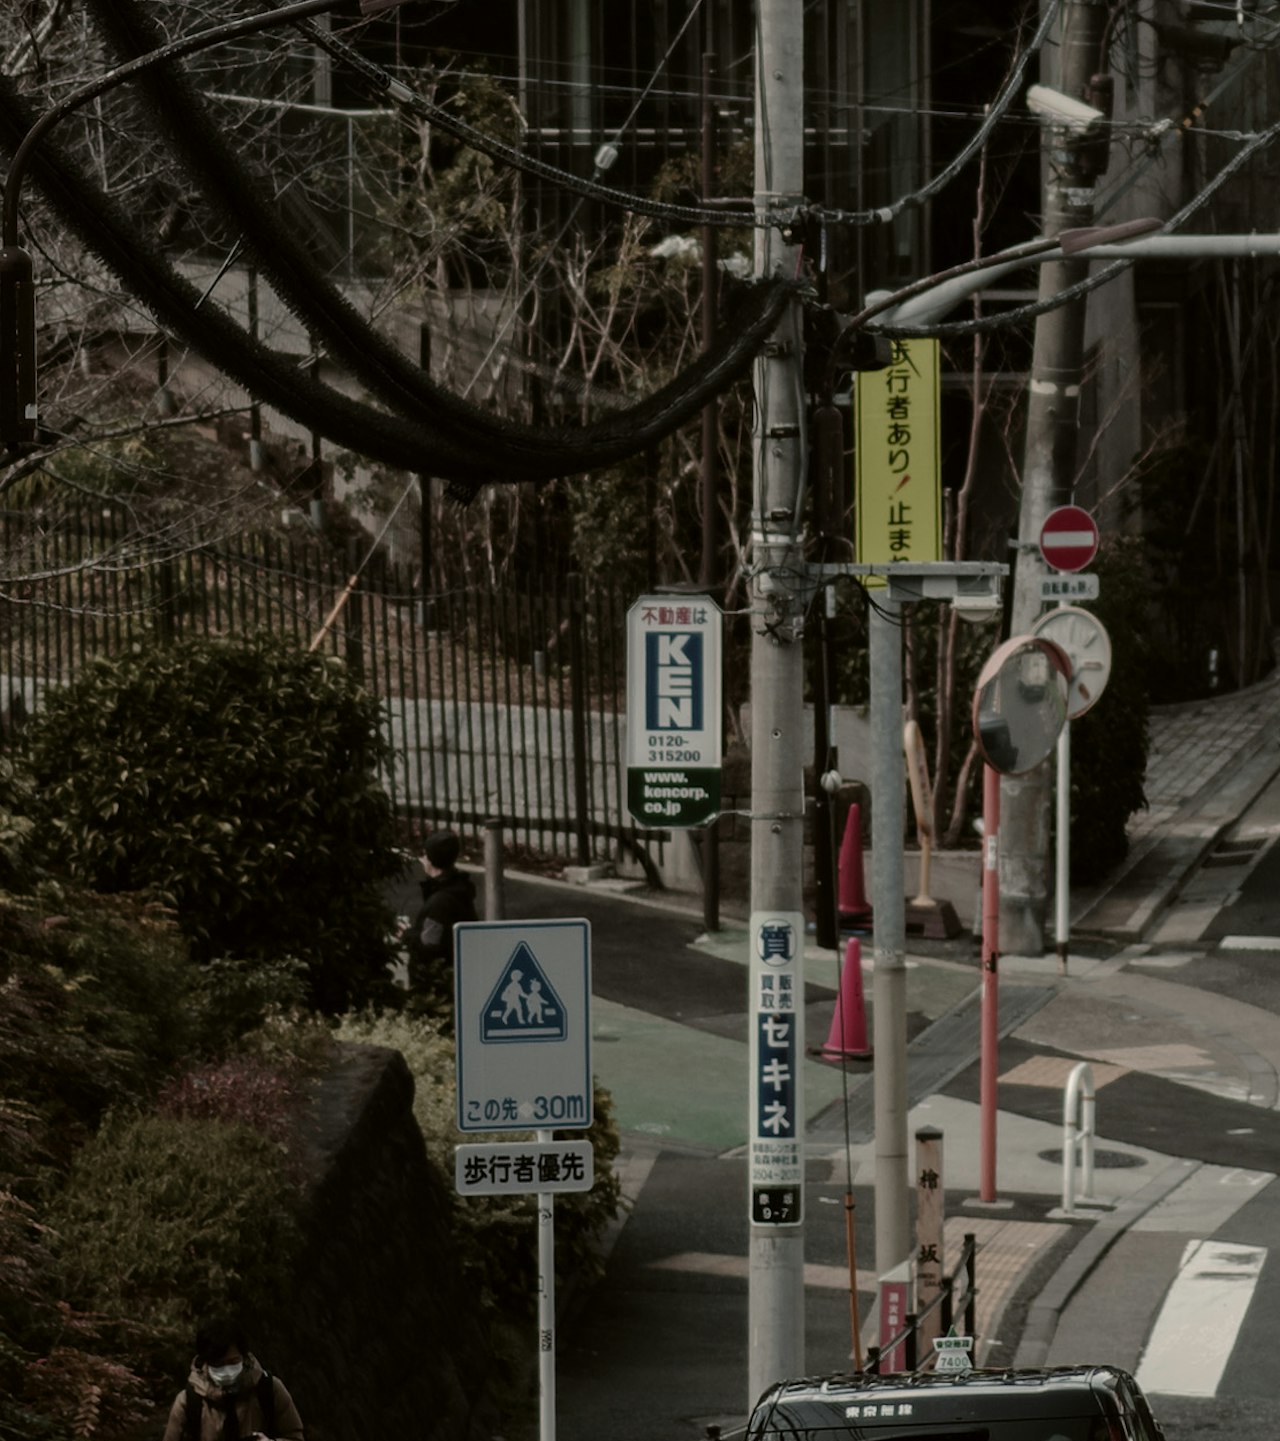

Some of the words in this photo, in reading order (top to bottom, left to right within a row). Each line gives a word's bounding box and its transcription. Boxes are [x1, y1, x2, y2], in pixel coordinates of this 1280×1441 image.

[886, 339, 912, 563] 歩行者あり！止ま
[641, 606, 708, 625] 不動産は
[657, 634, 693, 728] KEN
[648, 735, 689, 747] 0120-
[648, 750, 701, 762] 315200
[643, 771, 689, 784] www.
[643, 785, 709, 799] kencorp.
[643, 801, 681, 816] co.jp
[761, 1016, 792, 1136] セキネ
[467, 1097, 518, 1122] この先
[534, 1094, 584, 1120] 30m
[464, 1151, 585, 1185] 歩行者優先
[941, 1357, 969, 1367] 7400
